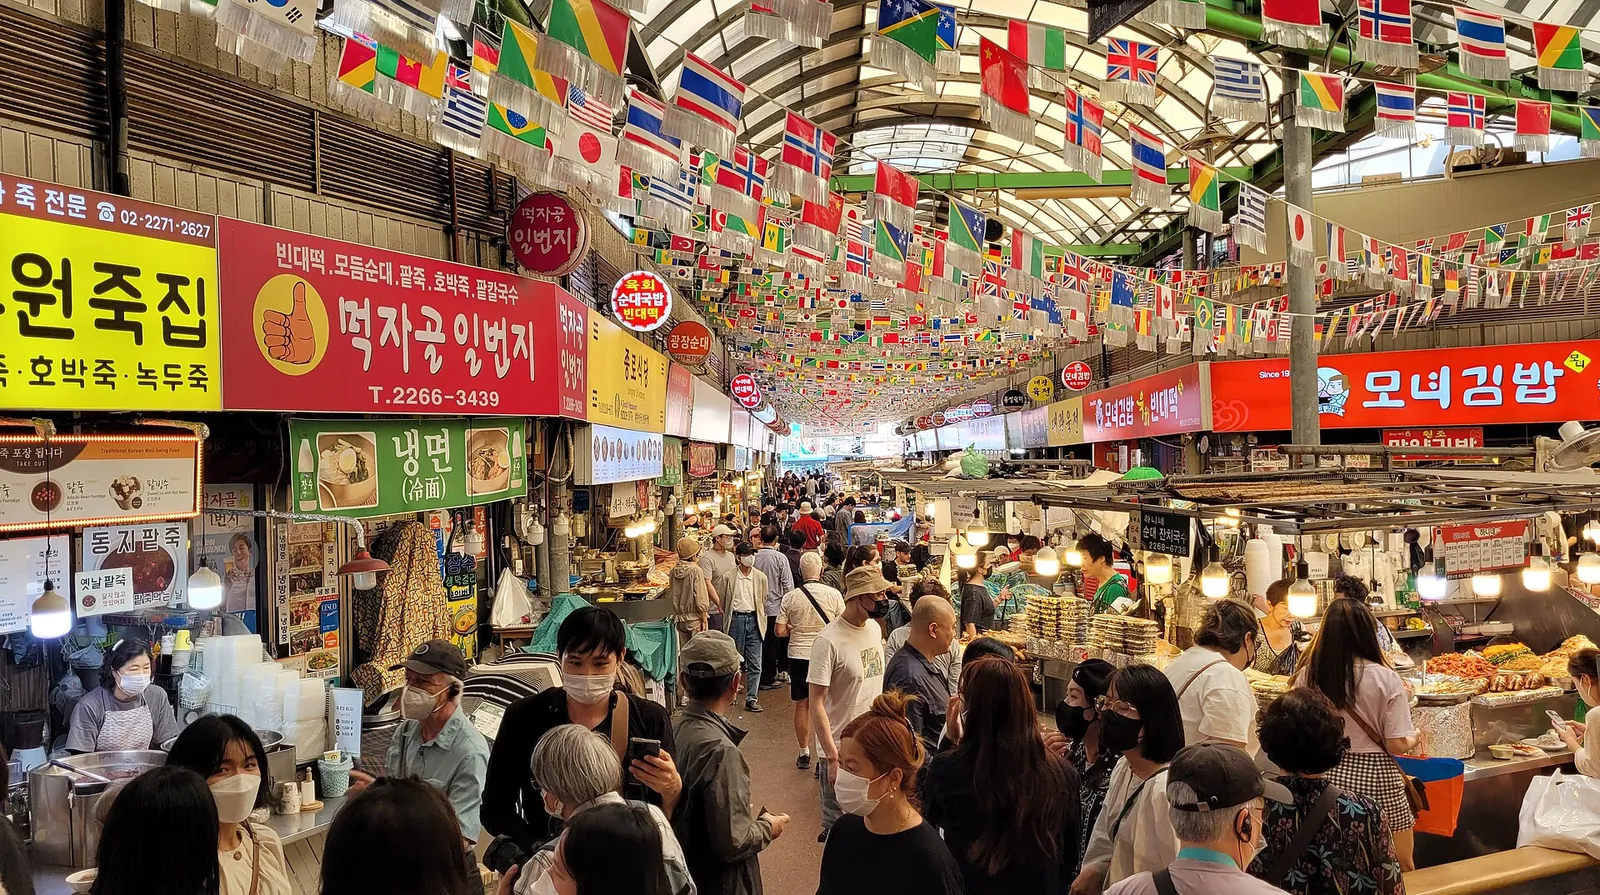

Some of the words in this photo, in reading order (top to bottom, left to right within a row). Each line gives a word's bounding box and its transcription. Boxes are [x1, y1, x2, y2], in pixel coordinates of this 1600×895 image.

[14, 182, 36, 210] 죽
[45, 188, 87, 219] 전문
[522, 206, 566, 224] 먹자골
[514, 227, 572, 254] 일번지
[0, 252, 207, 348] 원죽집
[617, 292, 664, 307] 순대국밥
[624, 308, 659, 320] 빈대떡
[560, 302, 584, 351] 먹자골
[670, 334, 709, 350] 광장순대
[561, 348, 584, 394] 일번지
[1066, 372, 1090, 380] 모녀김밥
[1259, 370, 1280, 378] Since
[1362, 360, 1565, 410] 모녀김밥
[368, 386, 500, 408] T.2266-3439
[1105, 395, 1134, 428] 모녀김밥
[1150, 386, 1178, 422] 빈대떡
[1422, 430, 1446, 438] 원조
[12, 447, 32, 459] 포장
[35, 446, 64, 459] 됩니다
[392, 428, 453, 477] 냉면
[0, 484, 10, 498] 죽
[66, 480, 84, 494] 팥죽
[402, 474, 446, 505] (冷面)
[1144, 514, 1165, 526] 하니네
[1142, 525, 1157, 540] 순대
[1158, 528, 1188, 545] 잔치국수
[1148, 542, 1187, 555] 2268-6738
[448, 554, 476, 575] 장수
[80, 577, 102, 591] 옛날
[104, 574, 126, 588] 팥죽
